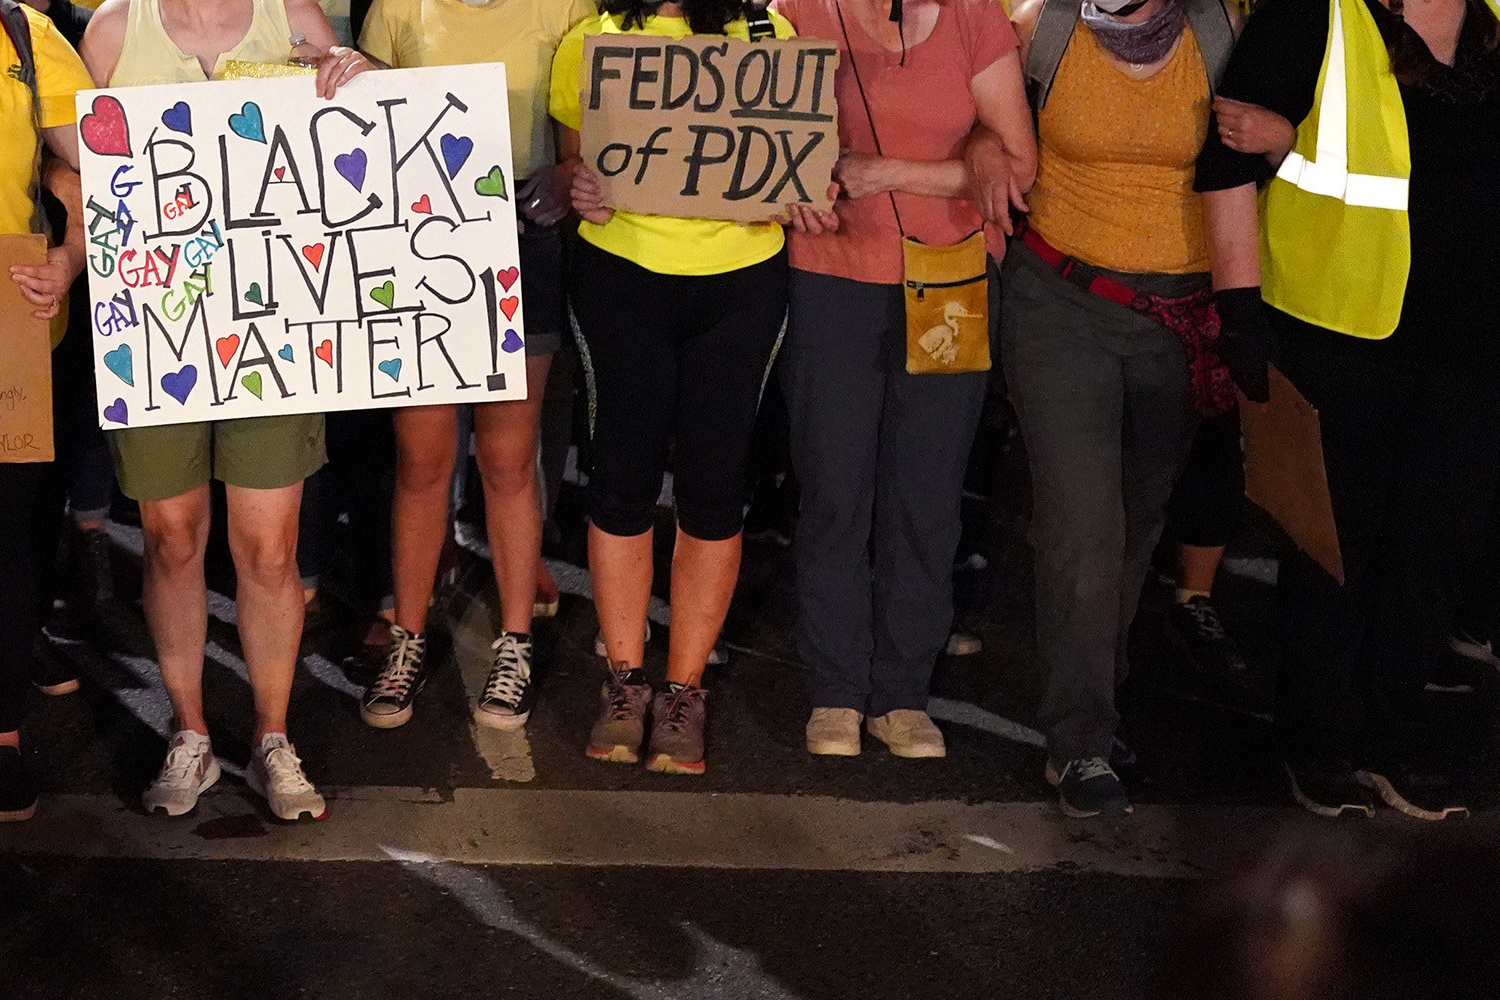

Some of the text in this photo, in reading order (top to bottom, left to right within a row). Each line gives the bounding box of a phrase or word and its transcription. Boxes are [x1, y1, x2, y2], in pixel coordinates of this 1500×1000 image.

[588, 41, 838, 115] FEDS OUT
[143, 92, 492, 244] BLACK
[596, 123, 826, 204] of PDX
[163, 182, 200, 220] GAY
[85, 195, 121, 278] GAY
[118, 243, 181, 288] GAY
[184, 219, 224, 268] GAY
[95, 288, 140, 337] GAY
[161, 262, 213, 322] GAY
